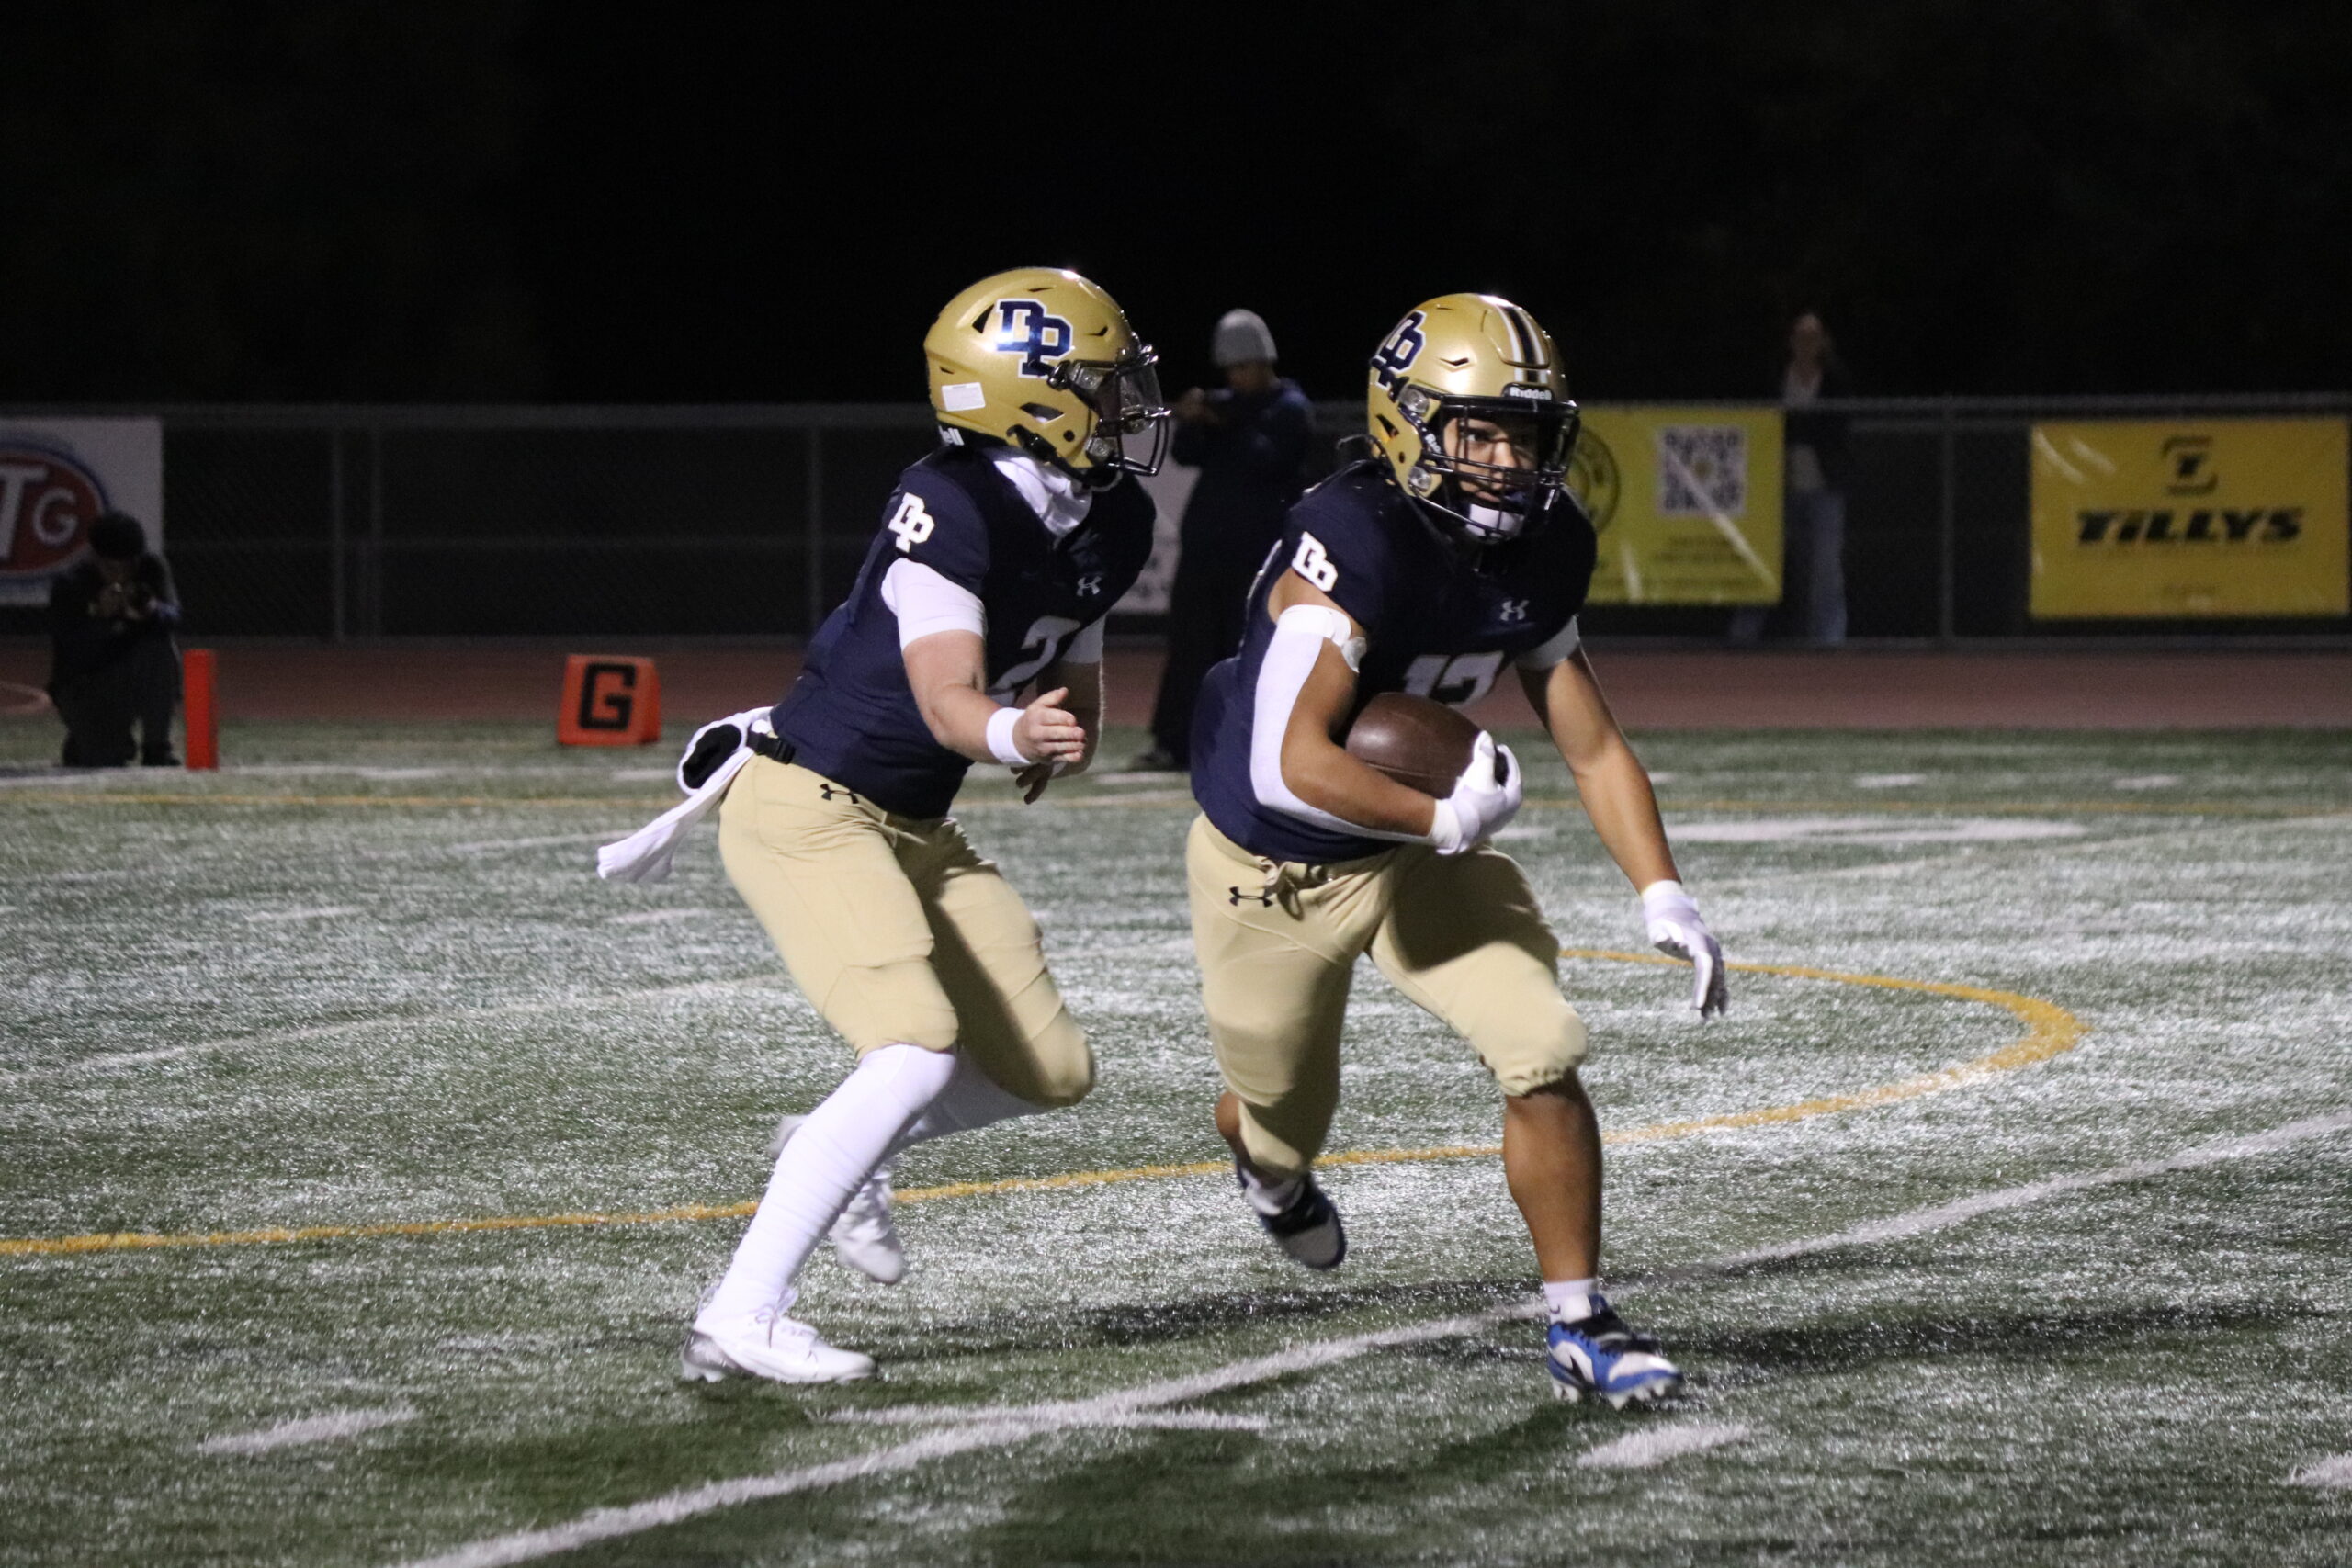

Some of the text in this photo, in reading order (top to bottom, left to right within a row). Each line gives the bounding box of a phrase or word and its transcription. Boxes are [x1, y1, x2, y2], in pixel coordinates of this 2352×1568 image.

[991, 299, 1069, 378] DP
[888, 492, 935, 553] DP
[578, 662, 636, 731] G
